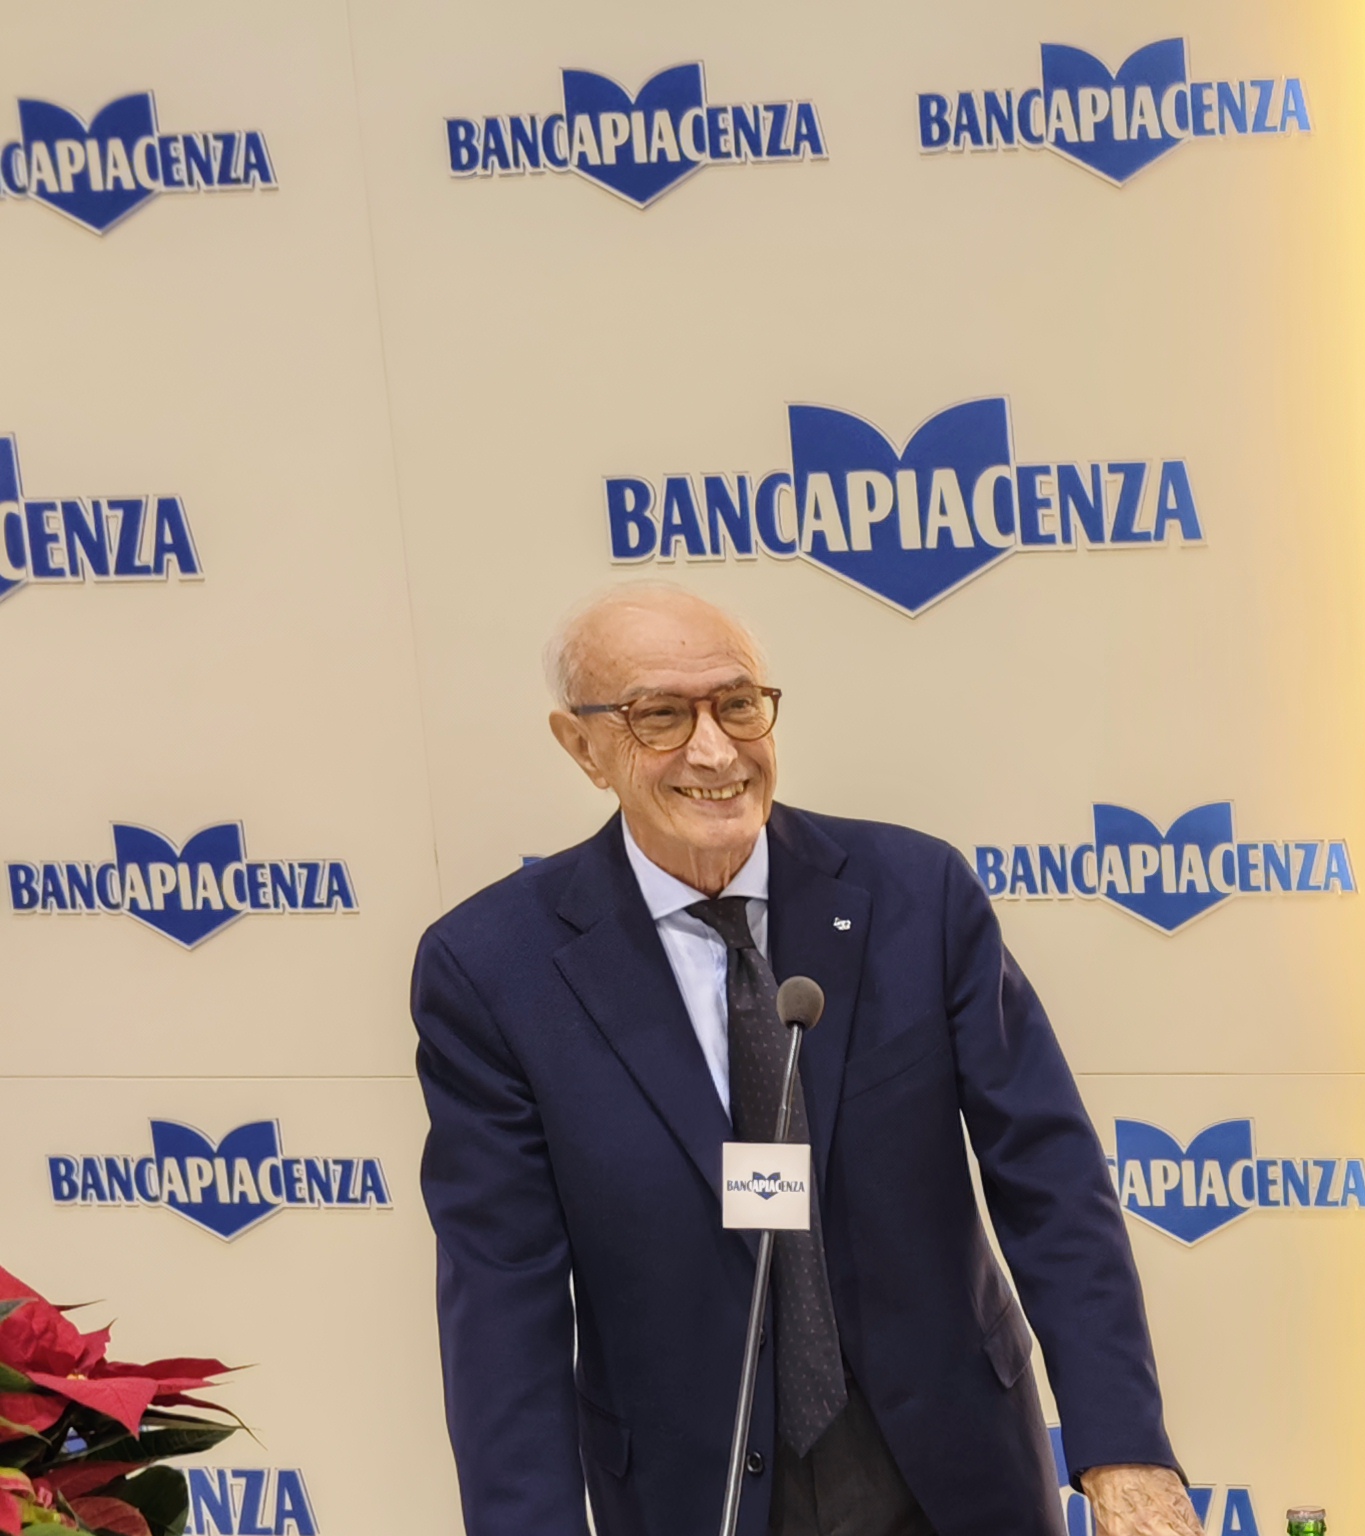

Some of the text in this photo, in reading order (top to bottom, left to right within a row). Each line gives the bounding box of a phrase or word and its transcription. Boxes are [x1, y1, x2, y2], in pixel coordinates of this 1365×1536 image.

[446, 102, 824, 173] BANCAPIACENZA
[917, 78, 1311, 148] BANCAPIACENZA
[606, 460, 1203, 561] BANCAPIACENZA
[8, 861, 354, 910] BANCAPIACENZA
[975, 842, 1357, 895] BANCAPIACENZA
[49, 1156, 391, 1205] BANCAPIACENZA
[727, 1180, 804, 1192] BANCAPIACENZA
